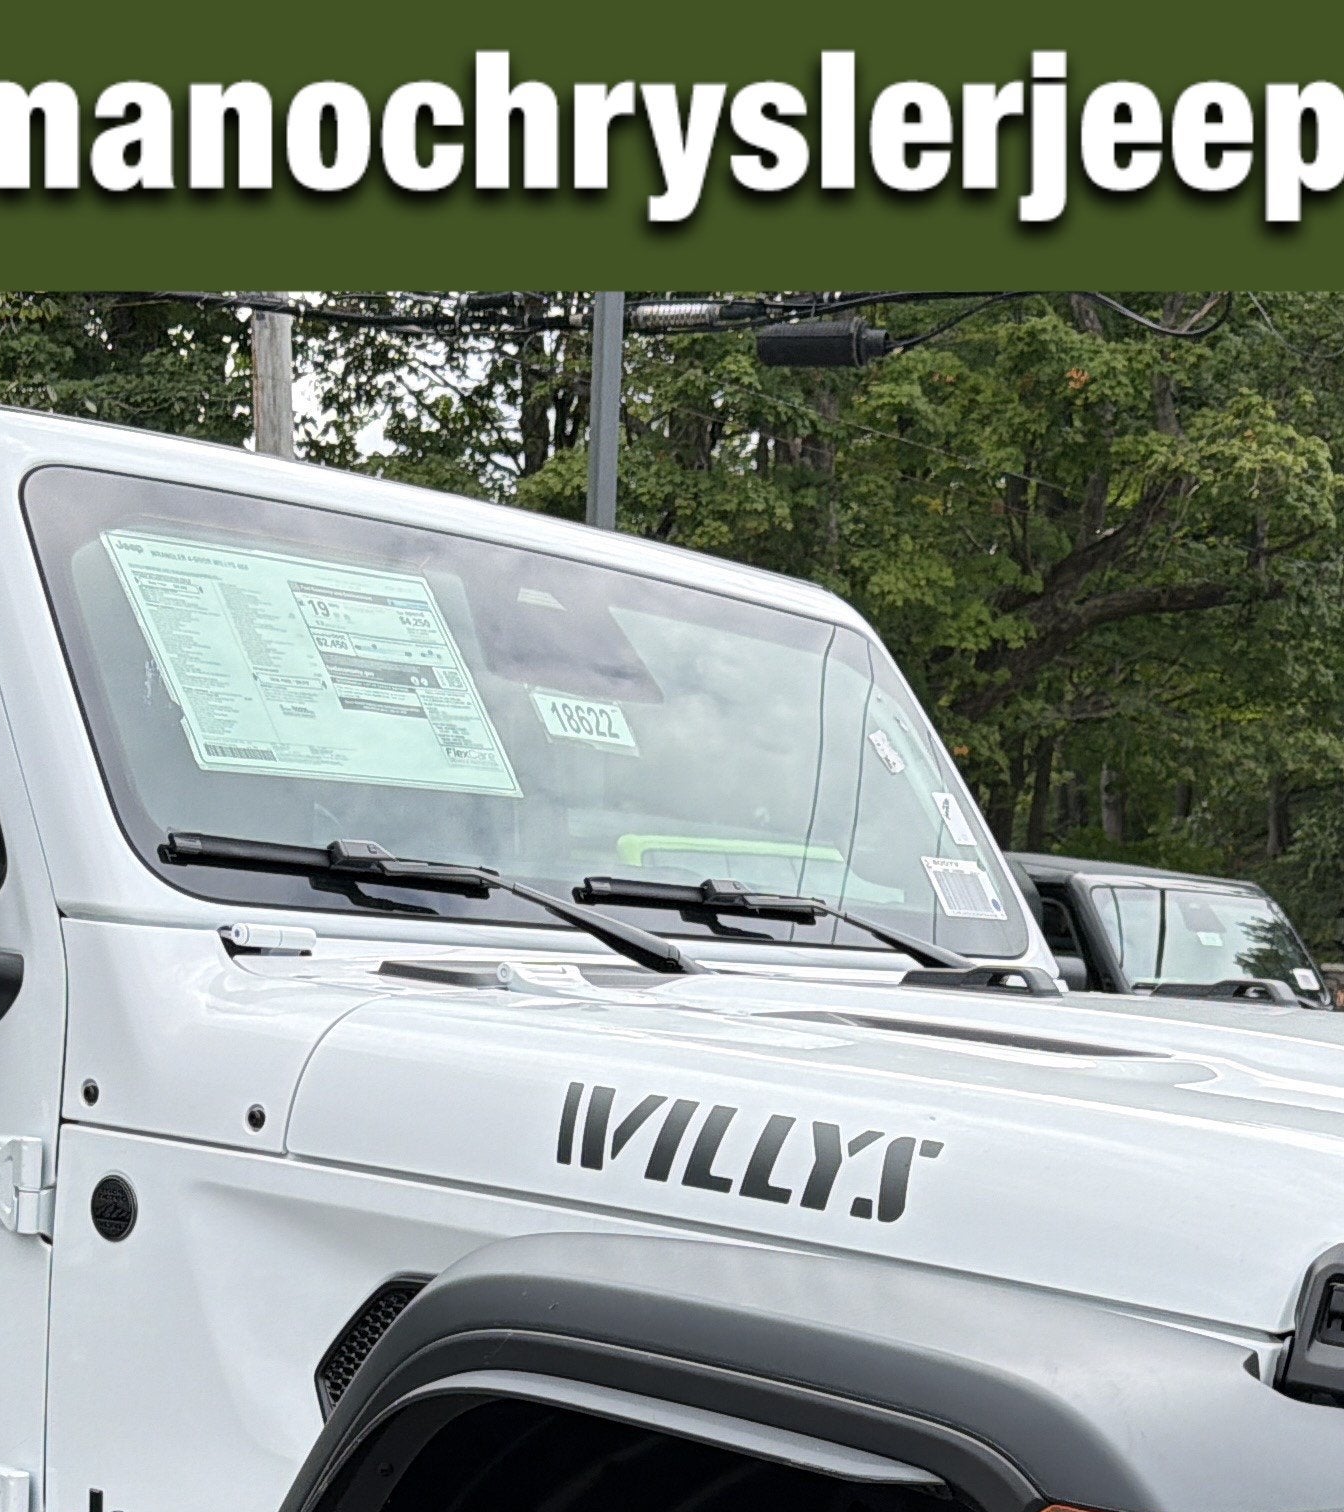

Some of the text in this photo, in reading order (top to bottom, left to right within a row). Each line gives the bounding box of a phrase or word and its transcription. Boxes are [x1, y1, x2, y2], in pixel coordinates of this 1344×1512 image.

[308, 599, 330, 618] 19
[551, 701, 620, 739] 18622
[556, 1081, 945, 1223] WILLYS
